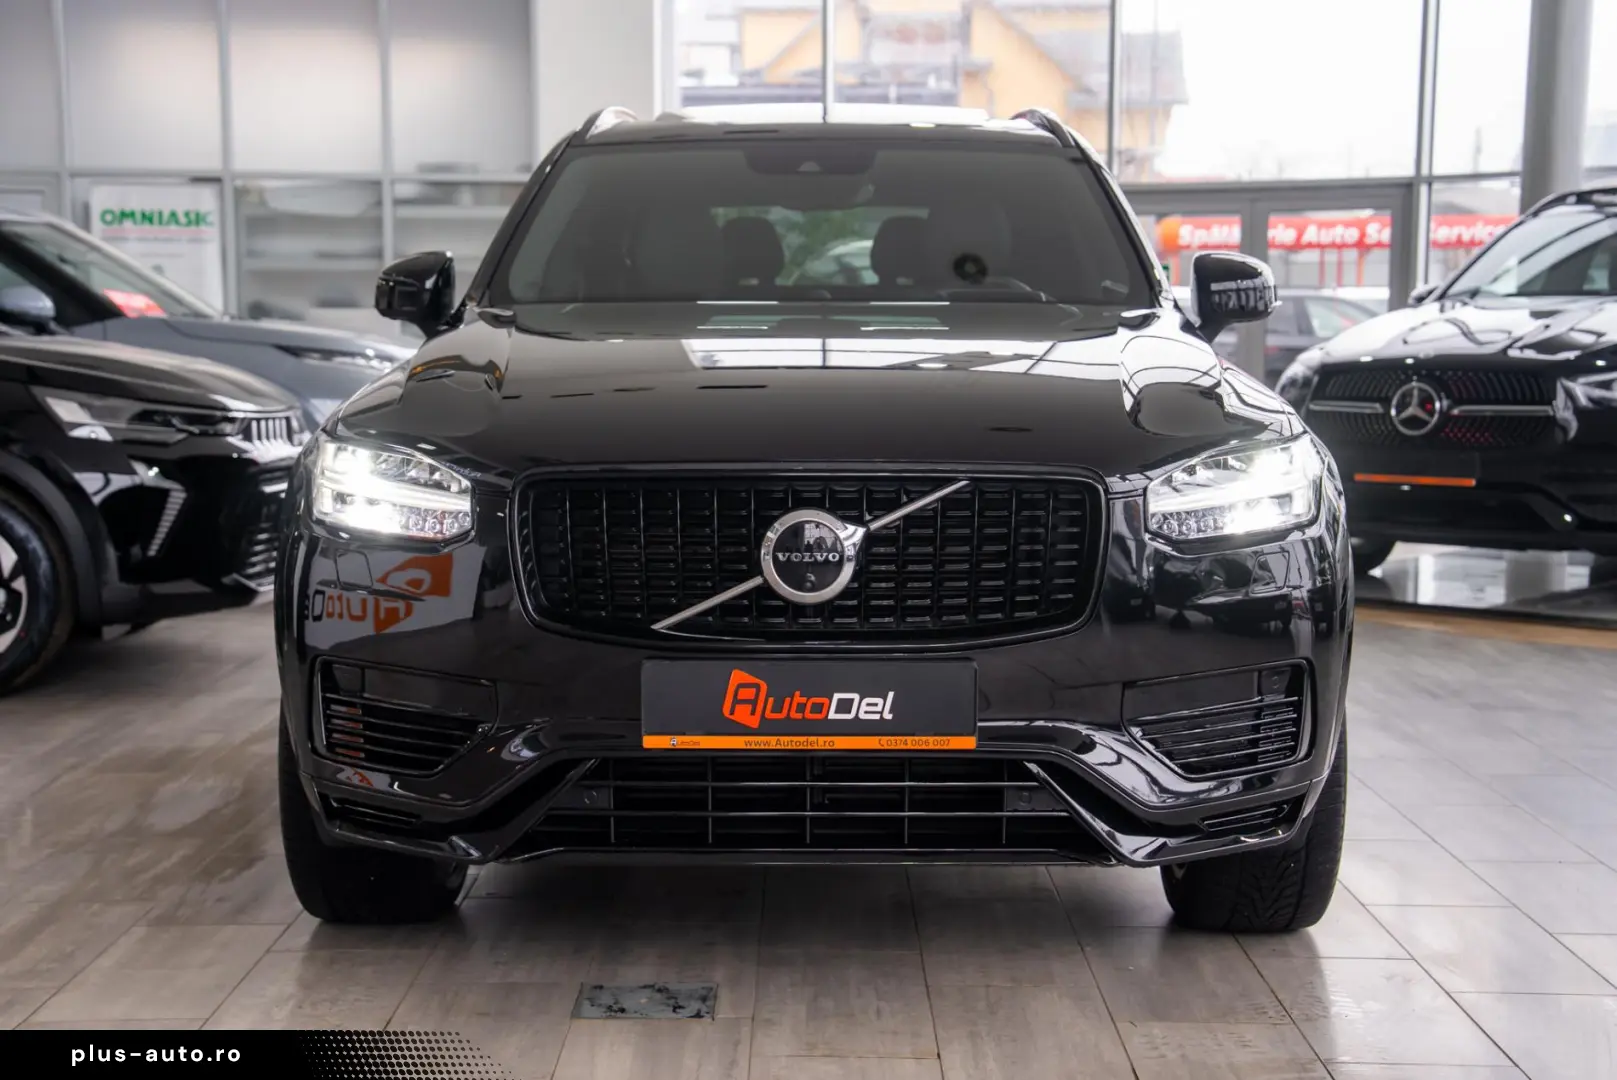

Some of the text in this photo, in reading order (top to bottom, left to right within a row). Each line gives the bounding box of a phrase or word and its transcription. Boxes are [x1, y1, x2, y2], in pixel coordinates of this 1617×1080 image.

[1301, 223, 1360, 245] Auto
[775, 552, 840, 562] VOLVO
[722, 669, 895, 728] AutoDel
[743, 737, 835, 748] www.Autodel.ro
[886, 738, 950, 748] 0374 006 007
